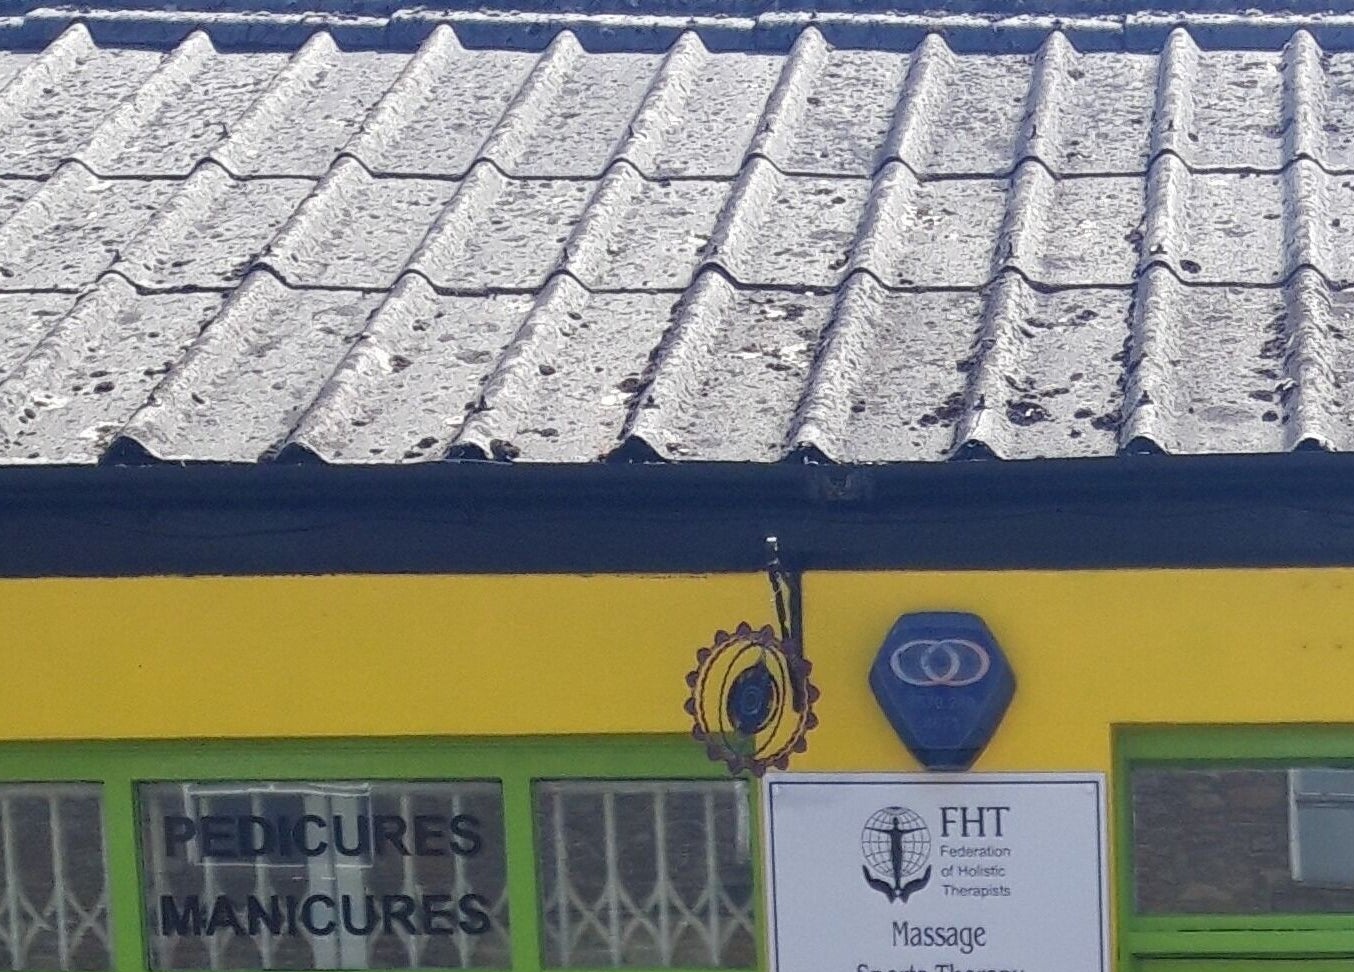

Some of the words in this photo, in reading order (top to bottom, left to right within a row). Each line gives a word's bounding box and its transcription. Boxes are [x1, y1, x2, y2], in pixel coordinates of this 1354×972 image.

[164, 815, 482, 859] PEDICURES
[940, 807, 1010, 837] FHT
[940, 845, 1011, 857] Federation
[941, 865, 953, 877] of
[957, 865, 1005, 877] Holistic
[942, 885, 1010, 897] Therapists
[159, 895, 493, 938] MANICURES
[893, 921, 986, 954] Massage
